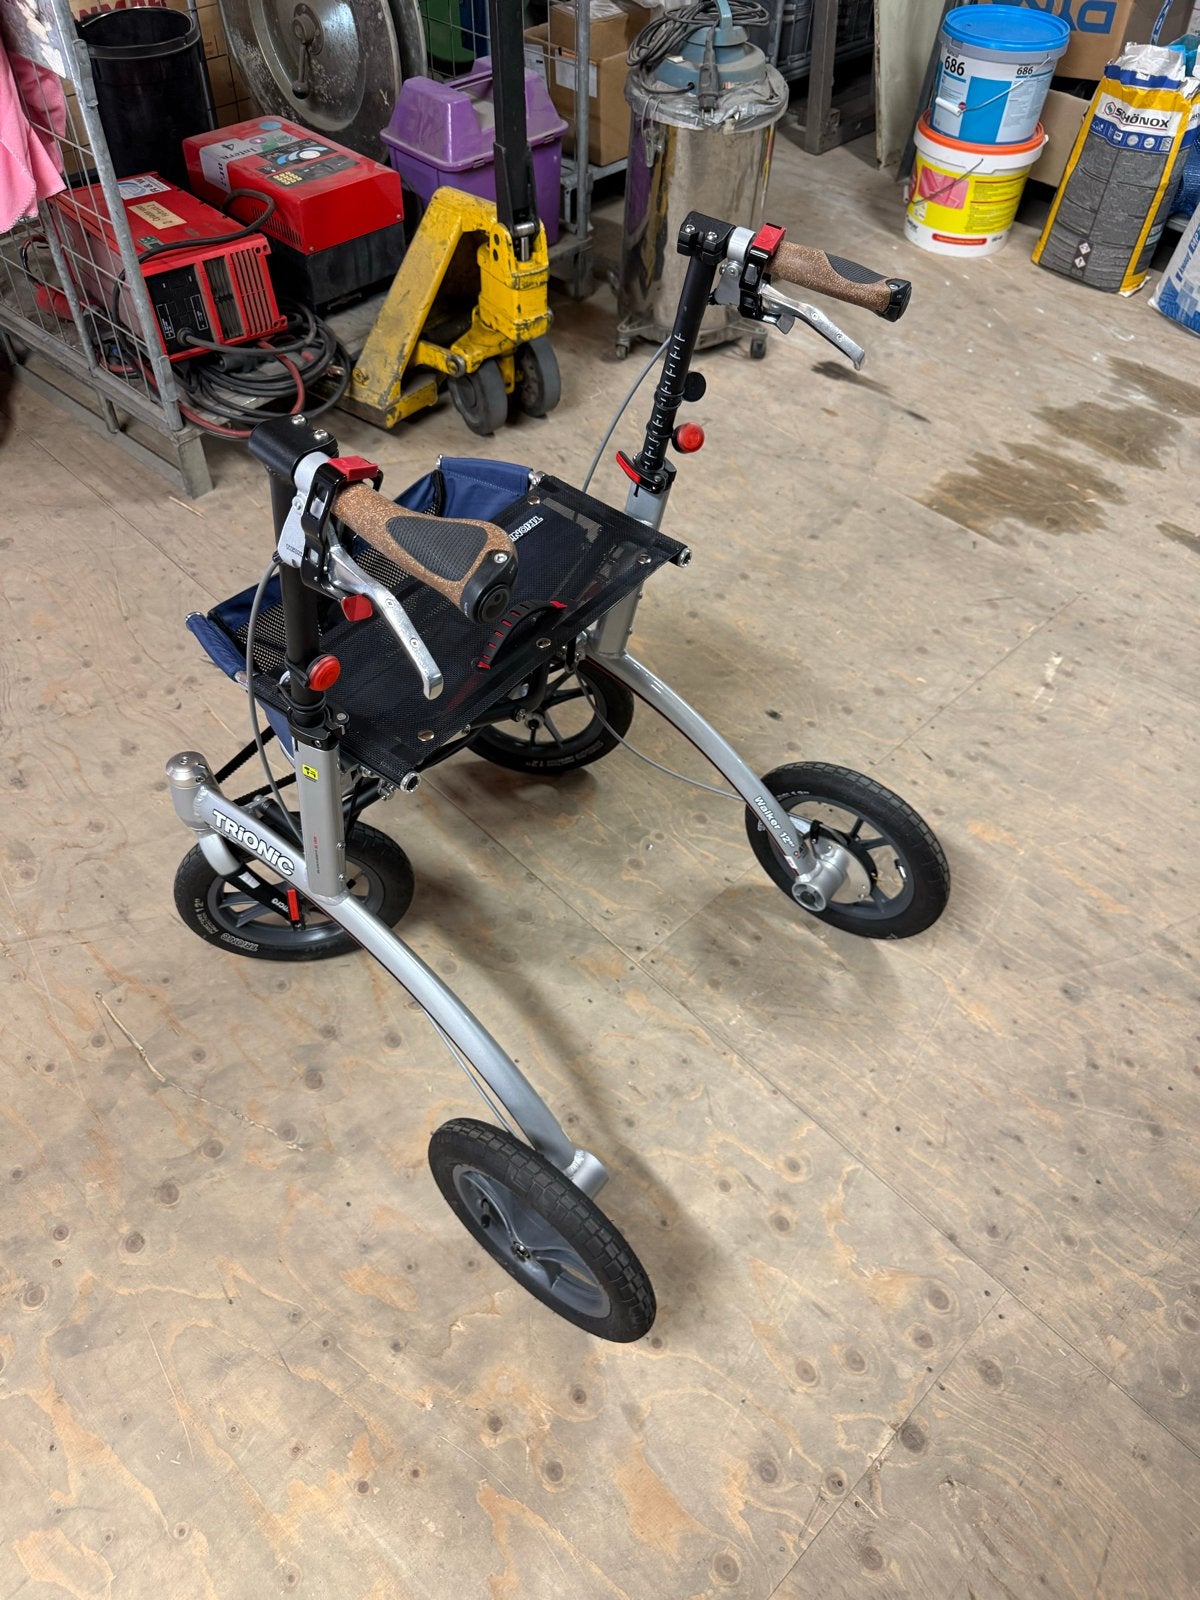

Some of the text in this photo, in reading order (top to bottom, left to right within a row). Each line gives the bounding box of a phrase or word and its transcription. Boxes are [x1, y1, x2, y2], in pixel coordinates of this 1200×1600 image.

[944, 56, 965, 76] 686
[1016, 66, 1034, 75] 686
[754, 796, 781, 829] Walker
